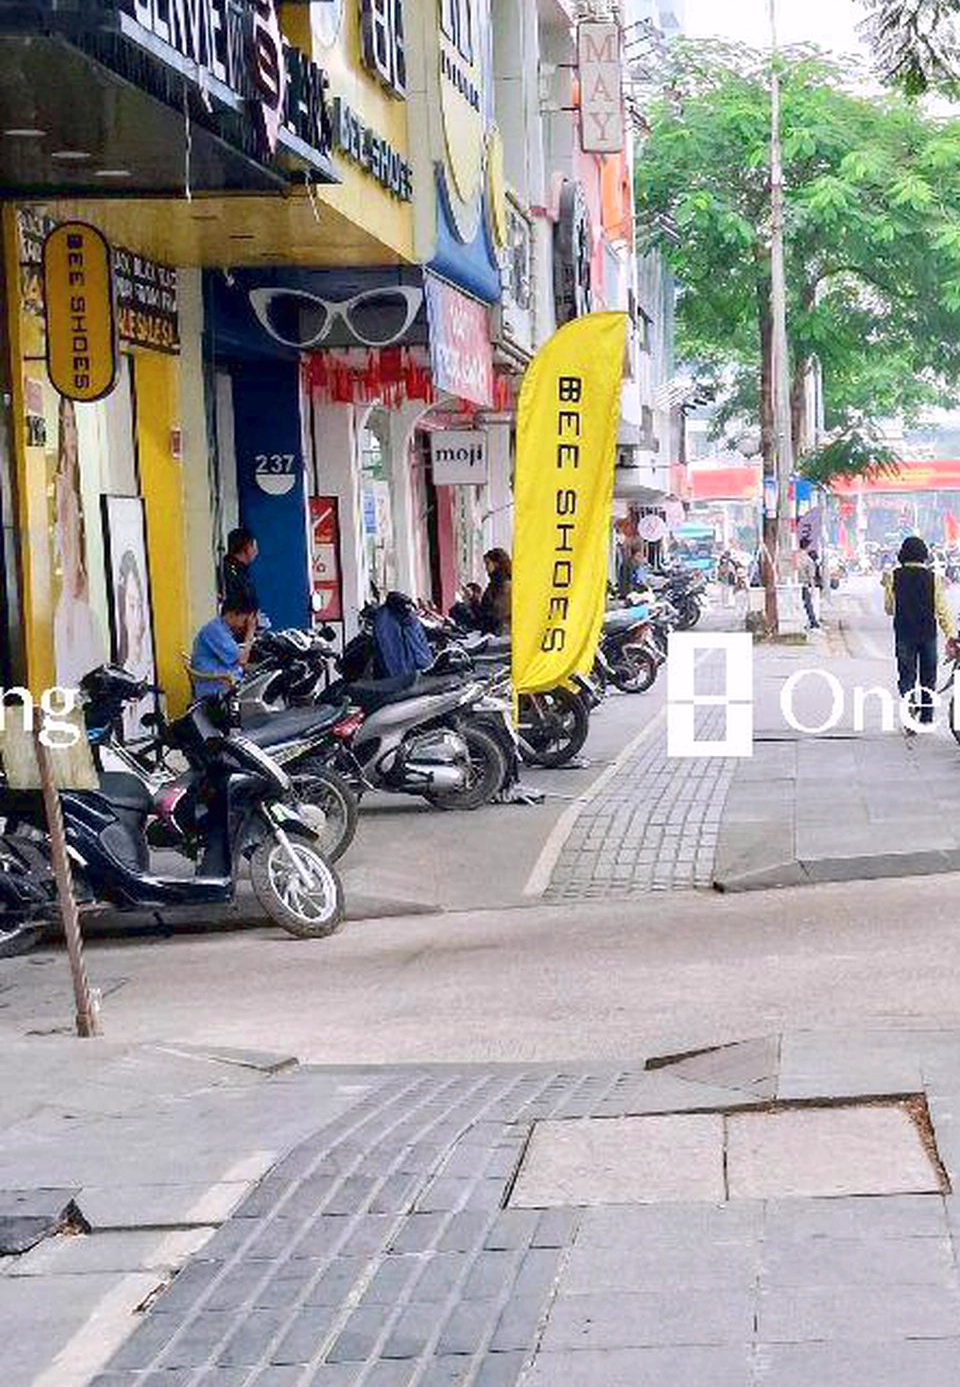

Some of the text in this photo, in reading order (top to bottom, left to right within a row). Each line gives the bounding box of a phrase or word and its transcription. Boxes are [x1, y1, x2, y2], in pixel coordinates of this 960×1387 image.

[583, 34, 616, 141] MAY
[66, 233, 90, 389] BEE SHOES
[255, 454, 295, 473] 237
[435, 443, 483, 467] moji
[541, 375, 582, 653] BEE SHOES
